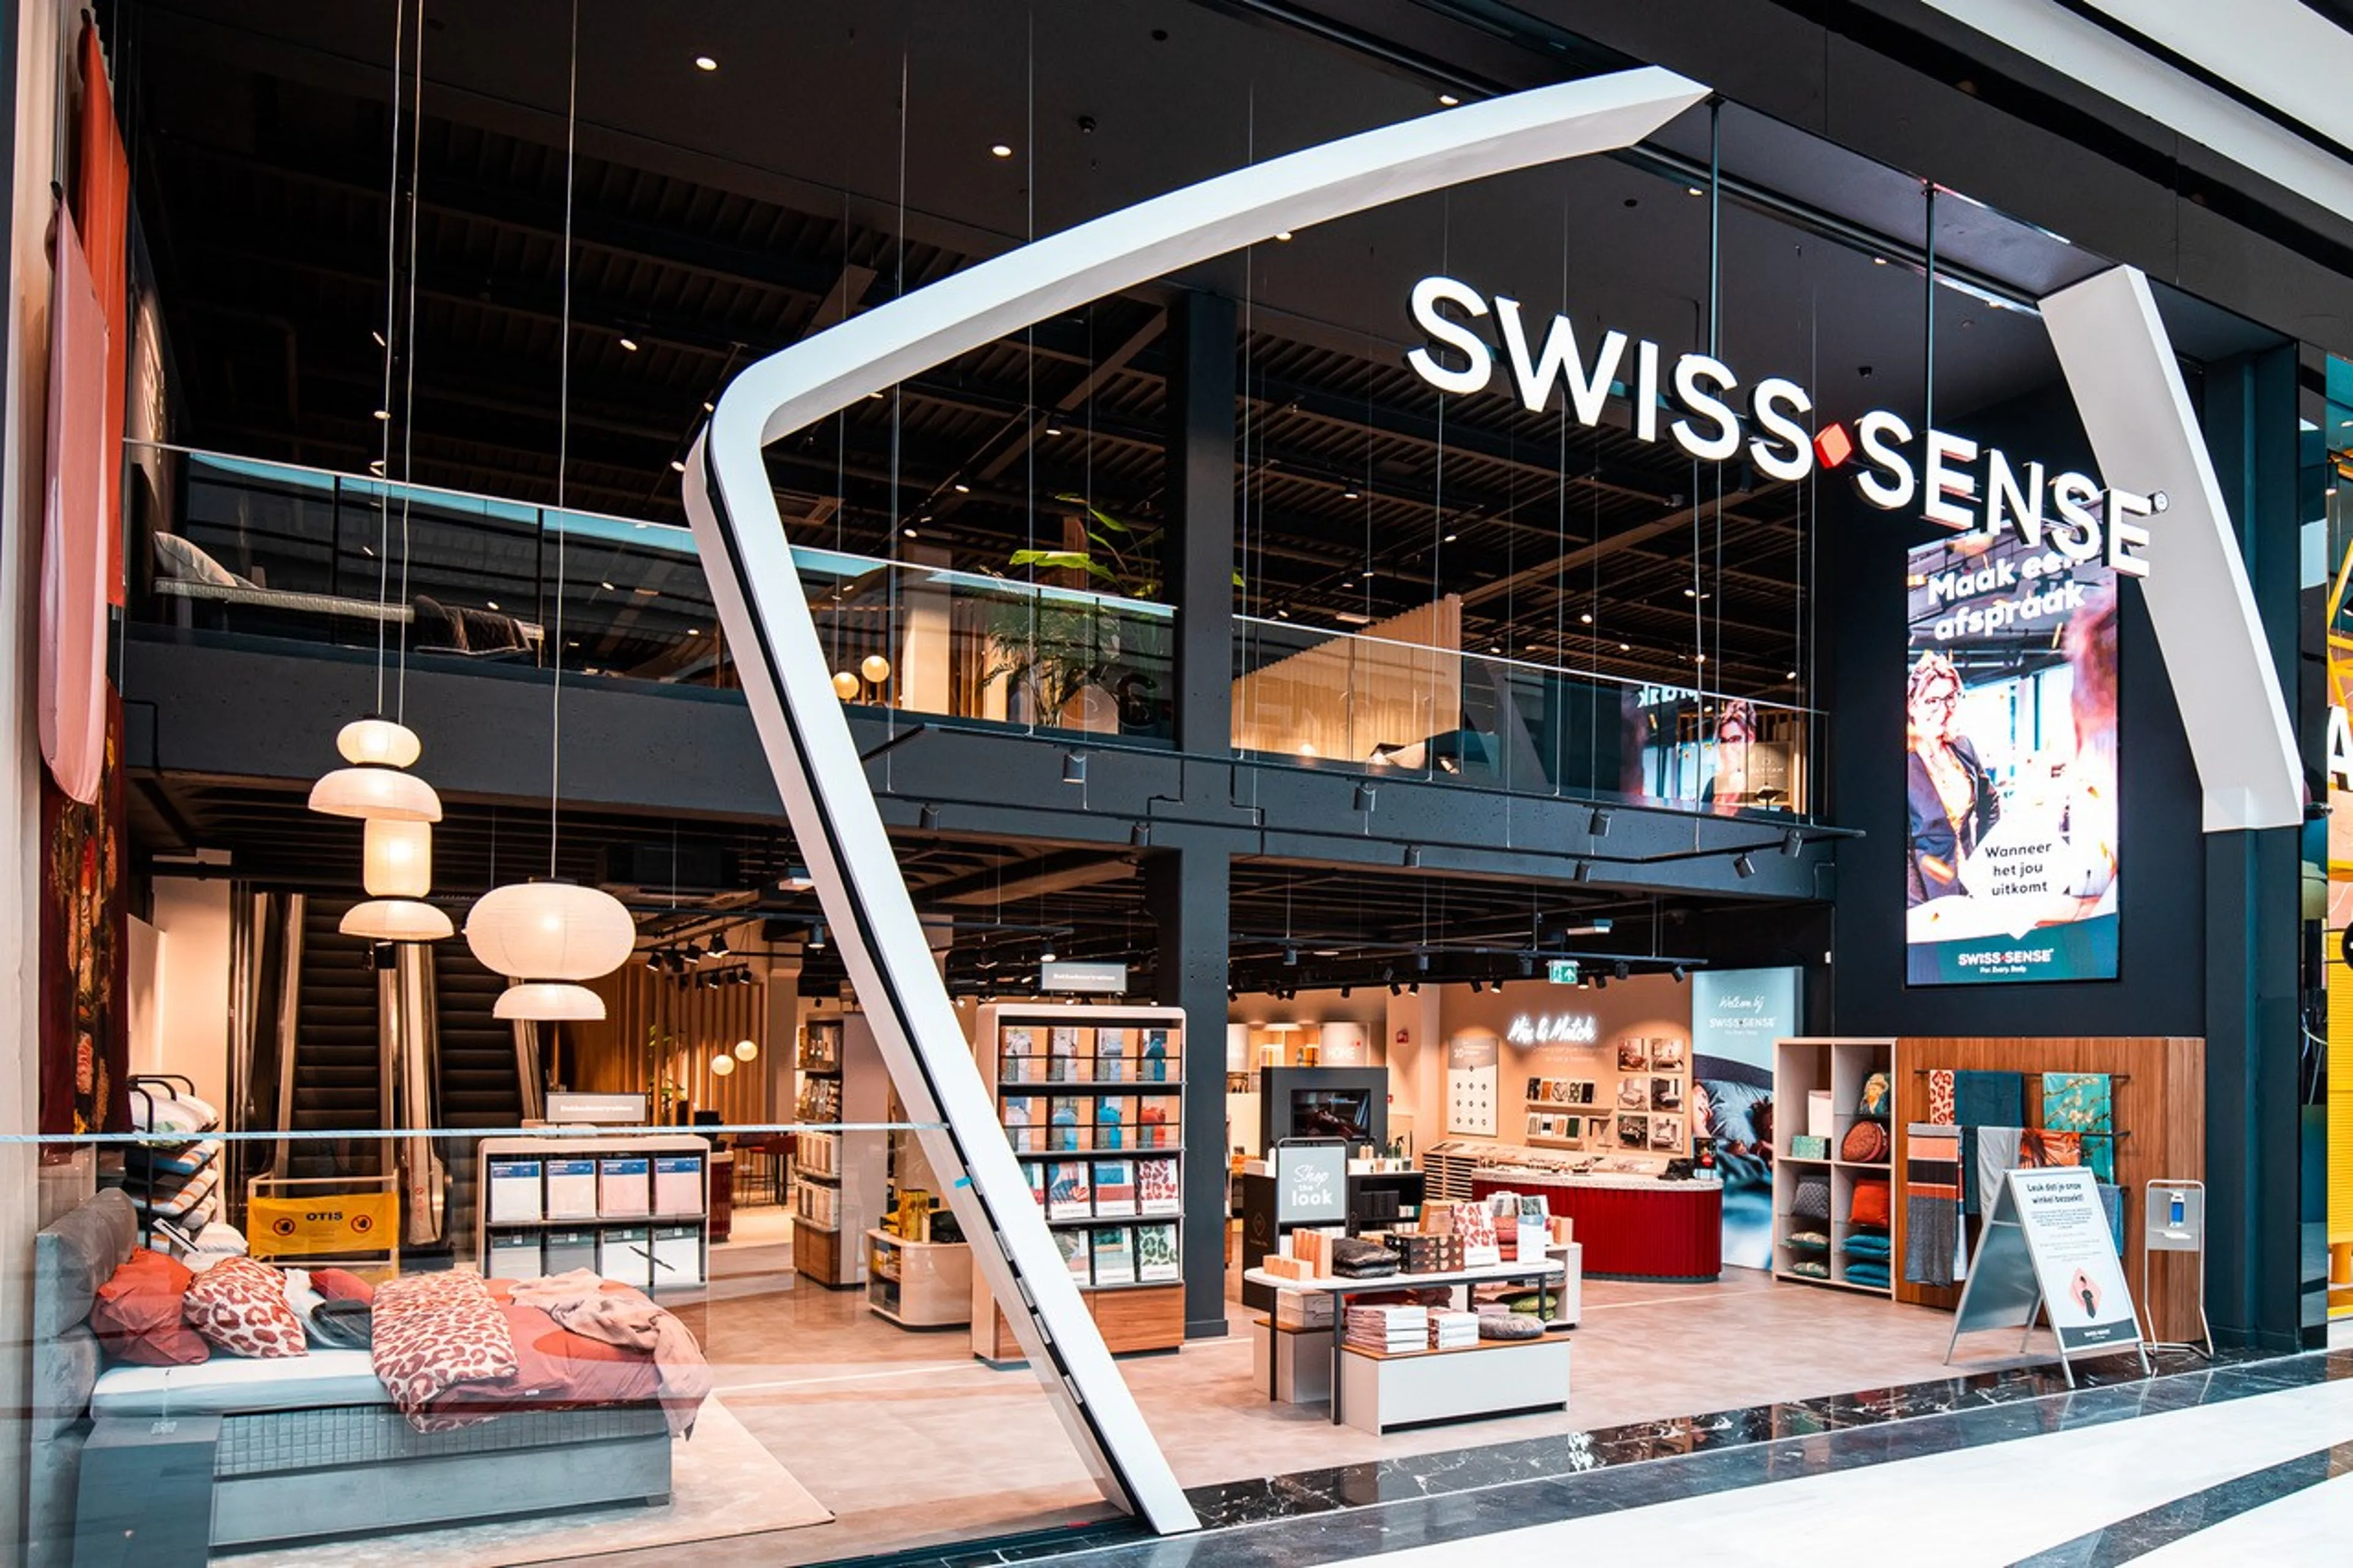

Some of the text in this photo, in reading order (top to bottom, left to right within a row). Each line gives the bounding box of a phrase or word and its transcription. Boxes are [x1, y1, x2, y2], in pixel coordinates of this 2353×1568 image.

[1928, 558, 2015, 605] Maak
[1934, 579, 2086, 640] afspraak
[1985, 843, 2052, 858] Wanneer
[1993, 862, 2043, 879] het jou
[1991, 881, 2048, 896] uitkomt
[1292, 1189, 1333, 1206] look
[306, 1211, 343, 1221] OTIS
